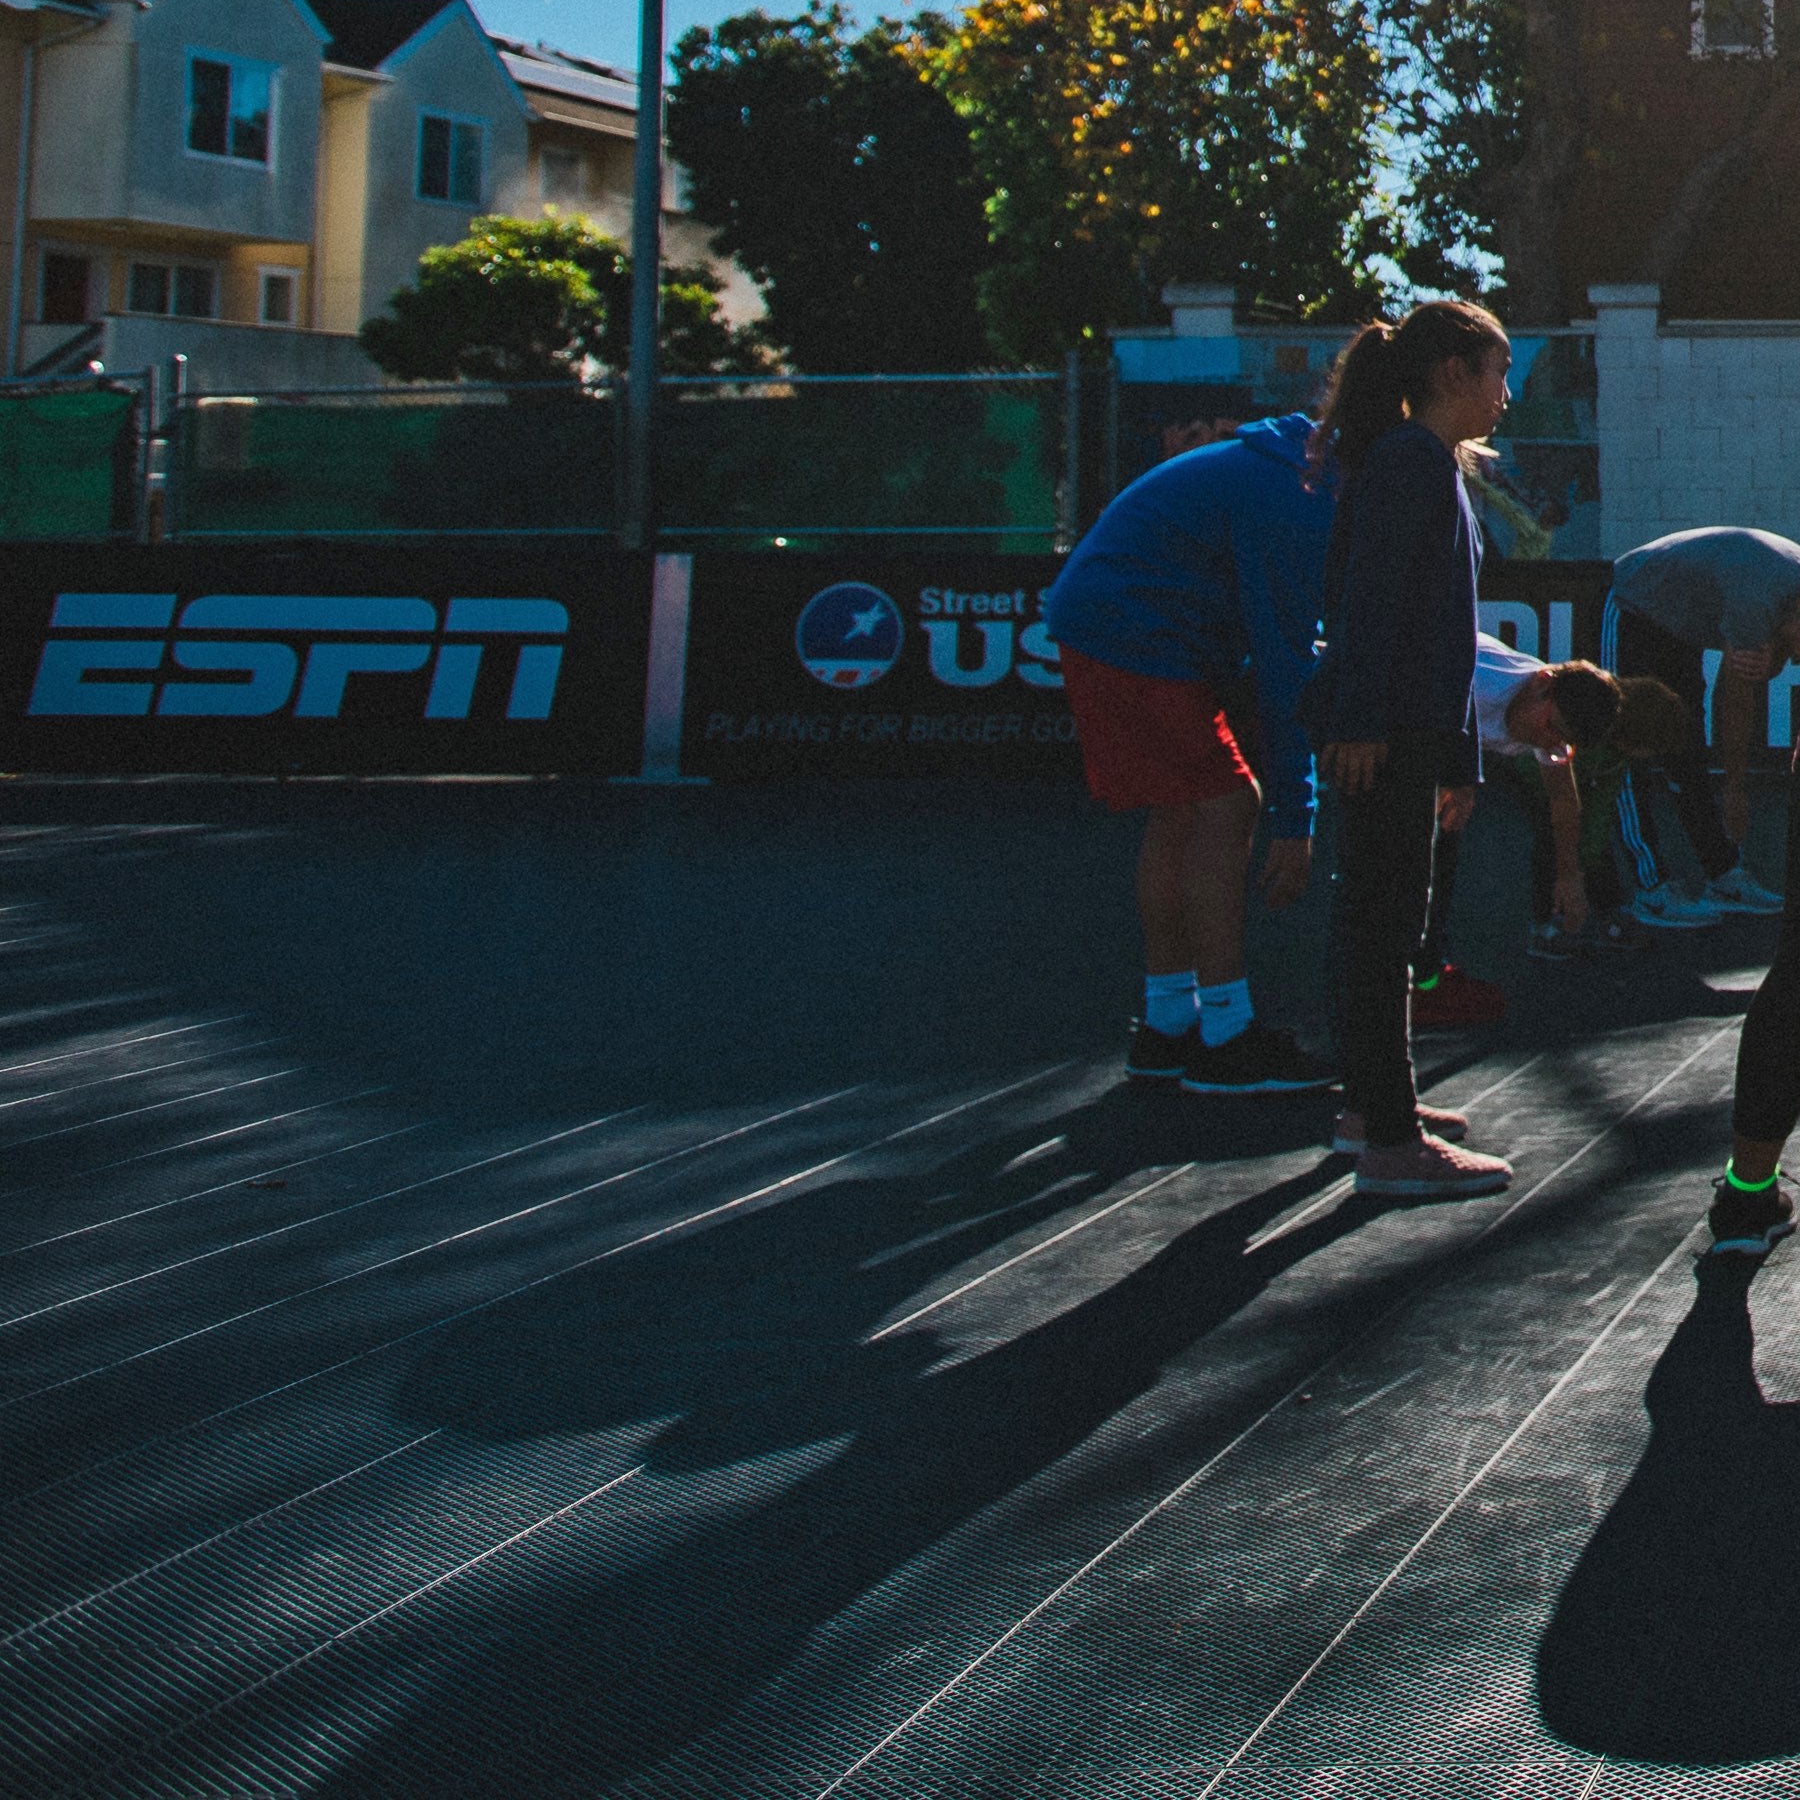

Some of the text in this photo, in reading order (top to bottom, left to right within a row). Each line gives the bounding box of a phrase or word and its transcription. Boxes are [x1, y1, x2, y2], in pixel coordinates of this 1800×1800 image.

[918, 585, 1027, 616] Street
[27, 592, 570, 720] ESPN
[704, 713, 832, 743] PLAYING
[838, 713, 902, 743] FOR
[907, 713, 1023, 743] BIGGER
